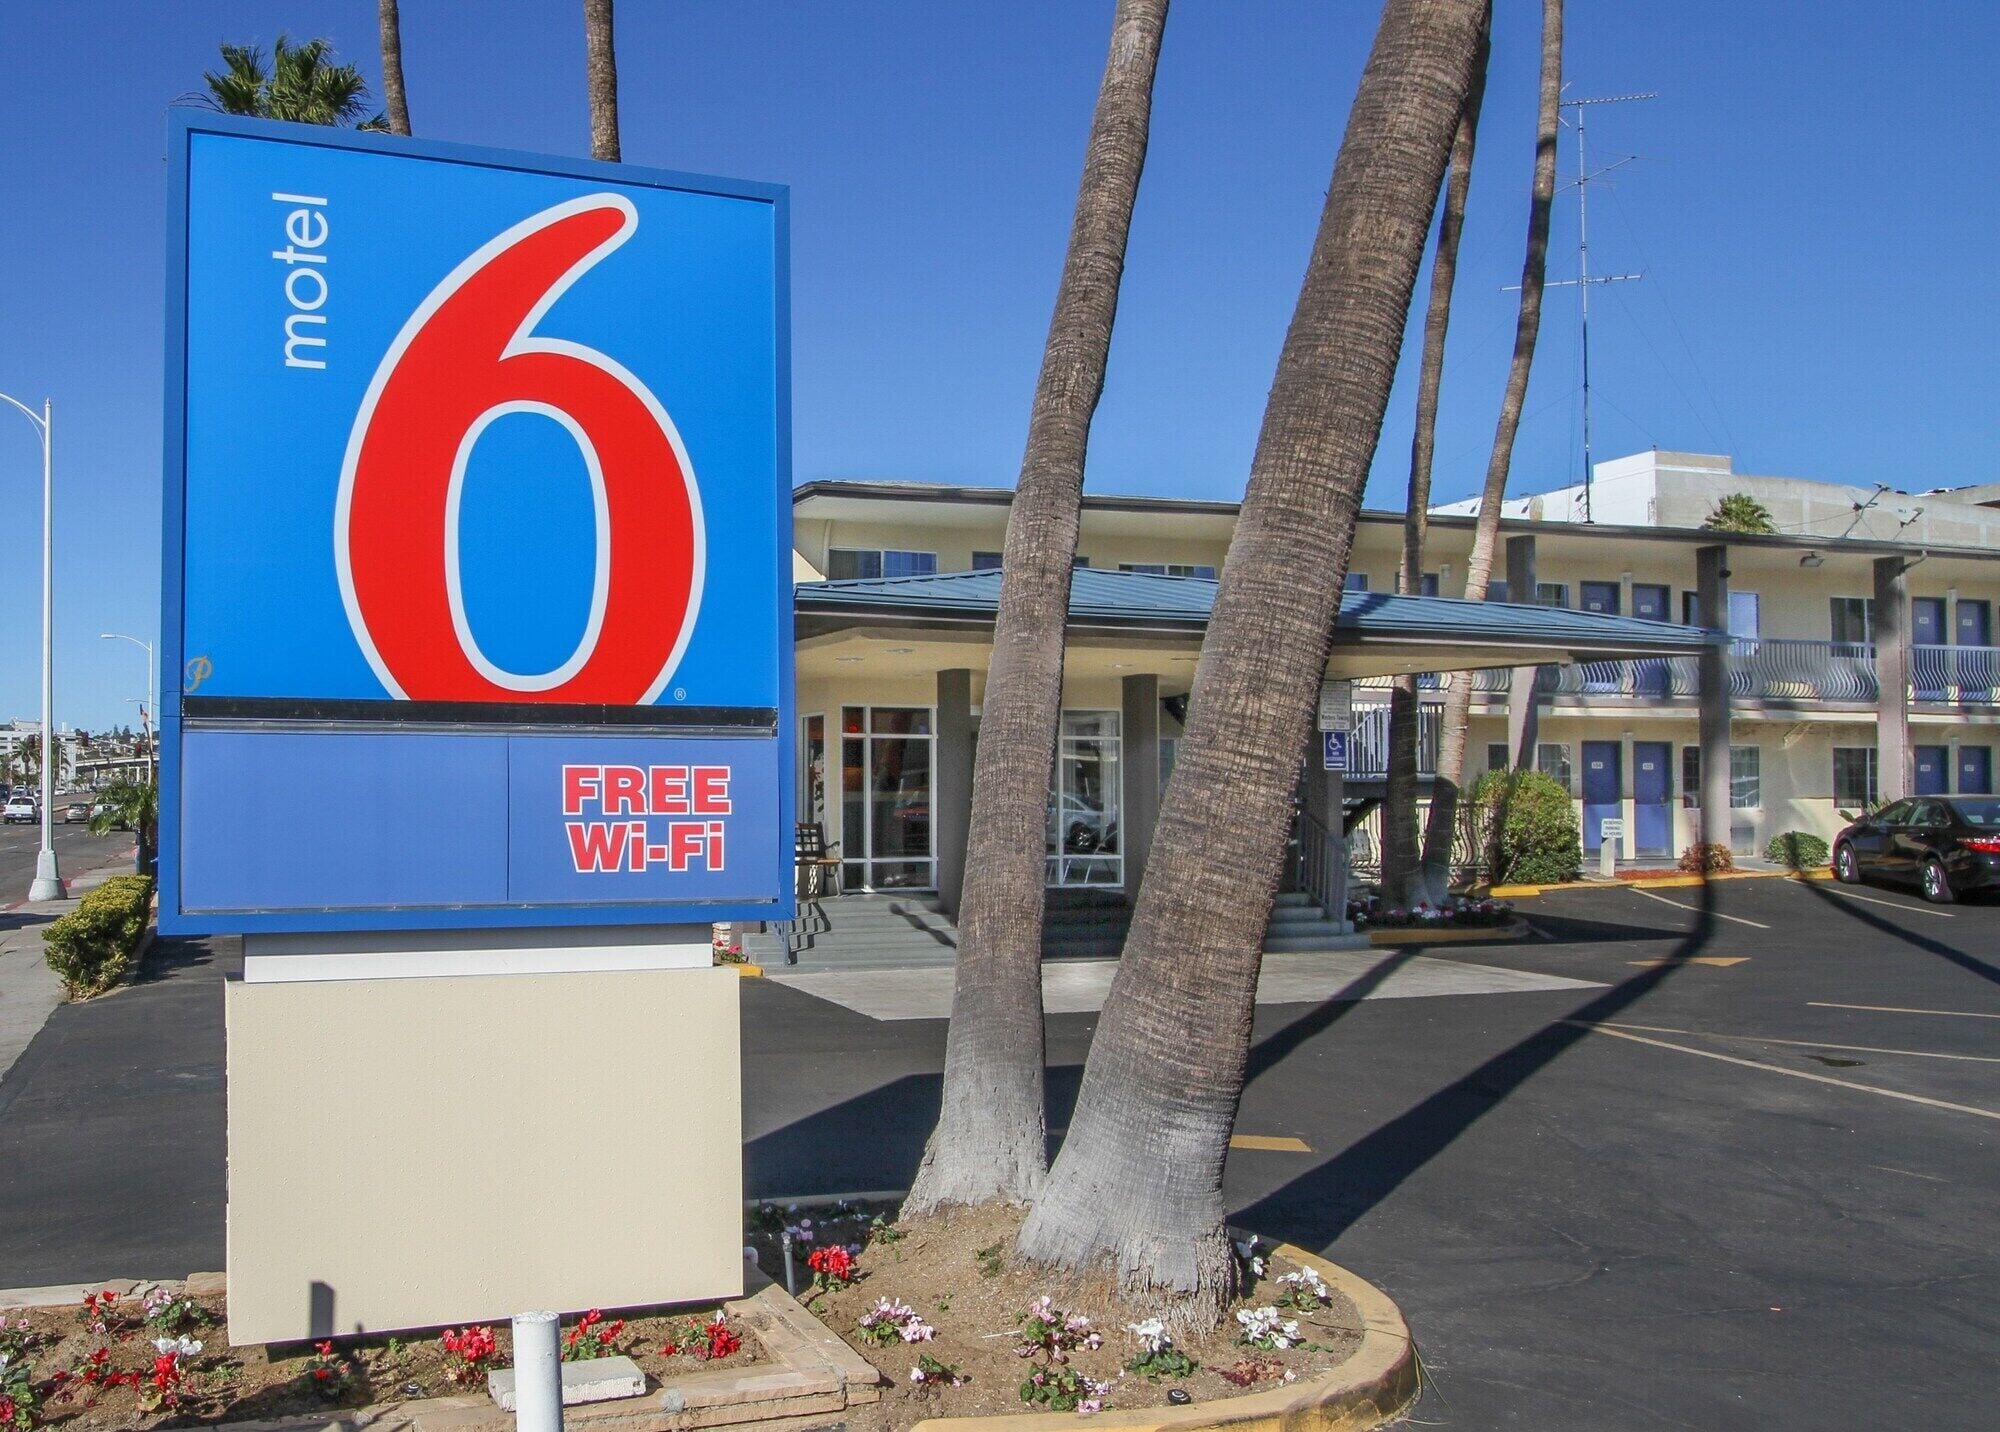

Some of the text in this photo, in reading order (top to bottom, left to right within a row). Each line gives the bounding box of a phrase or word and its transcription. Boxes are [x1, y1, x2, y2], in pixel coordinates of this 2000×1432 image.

[272, 192, 329, 370] motel
[334, 192, 706, 706] 6
[562, 764, 732, 816] FREE
[565, 820, 725, 873] Wi-Fi
